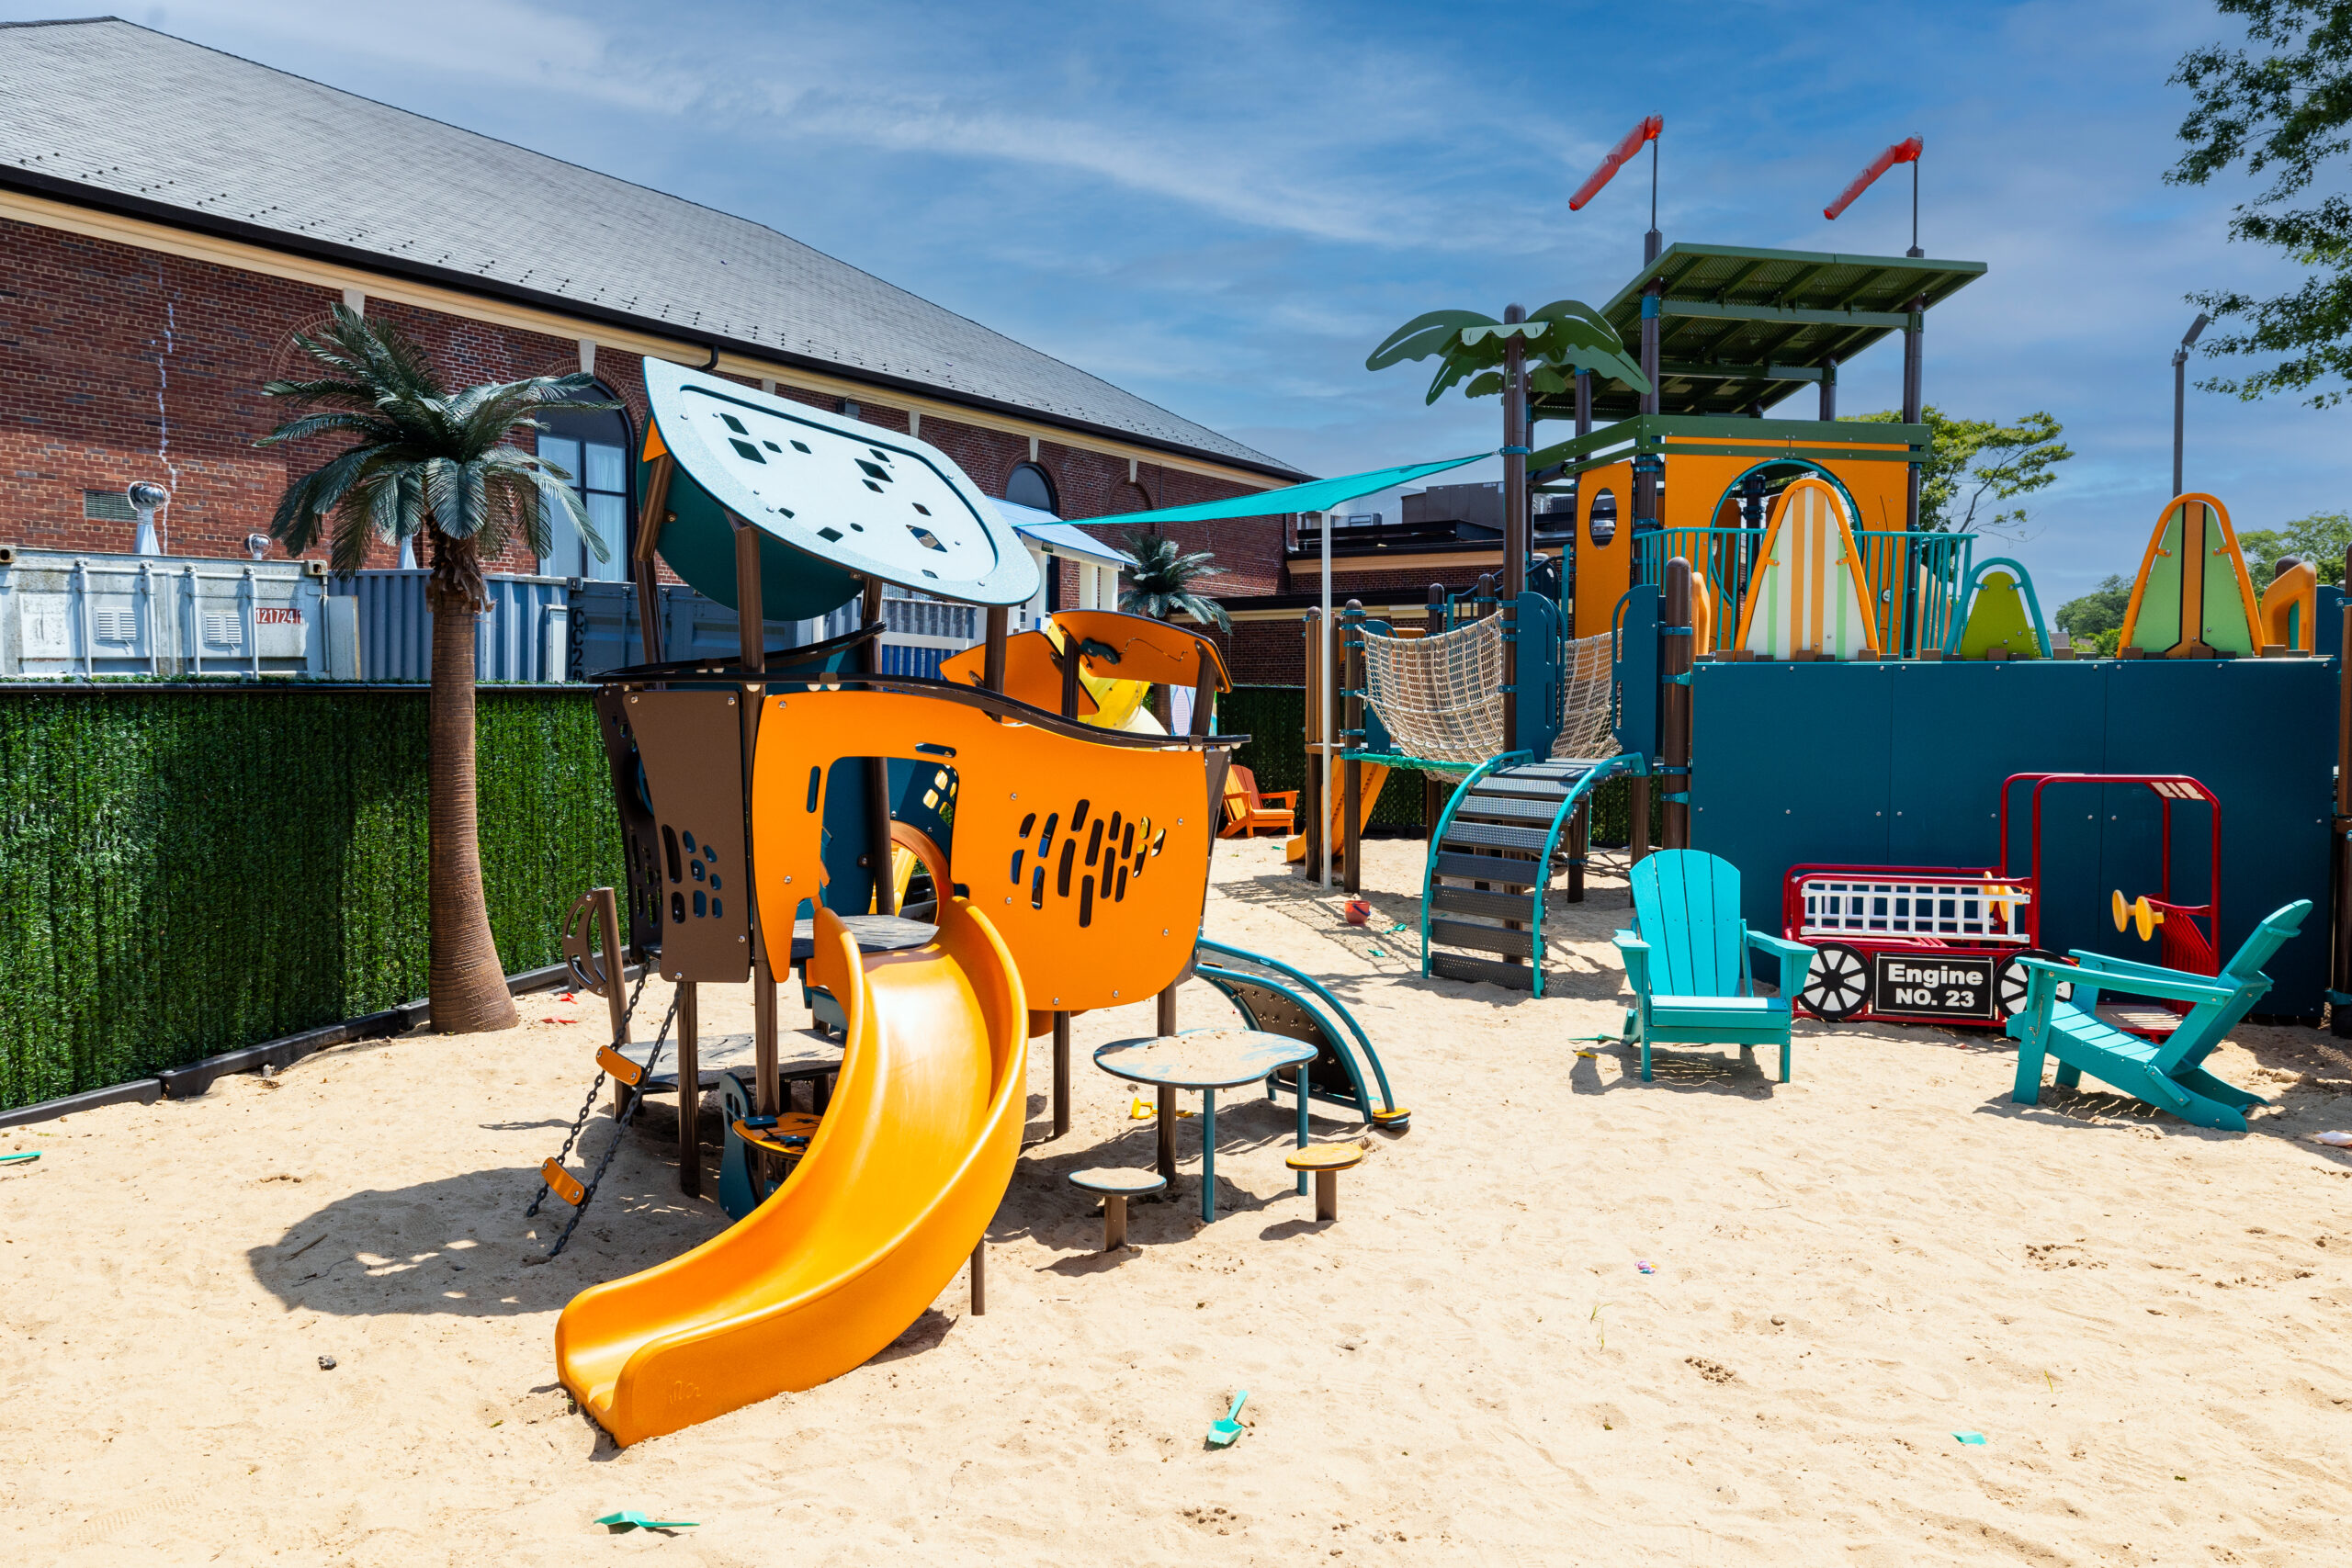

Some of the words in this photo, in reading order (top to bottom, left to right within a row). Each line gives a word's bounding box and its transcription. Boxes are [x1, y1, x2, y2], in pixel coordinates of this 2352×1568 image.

[1888, 963, 1984, 988] Engine
[1895, 987, 1939, 1006] NO.
[1945, 989, 1975, 1008] 23
